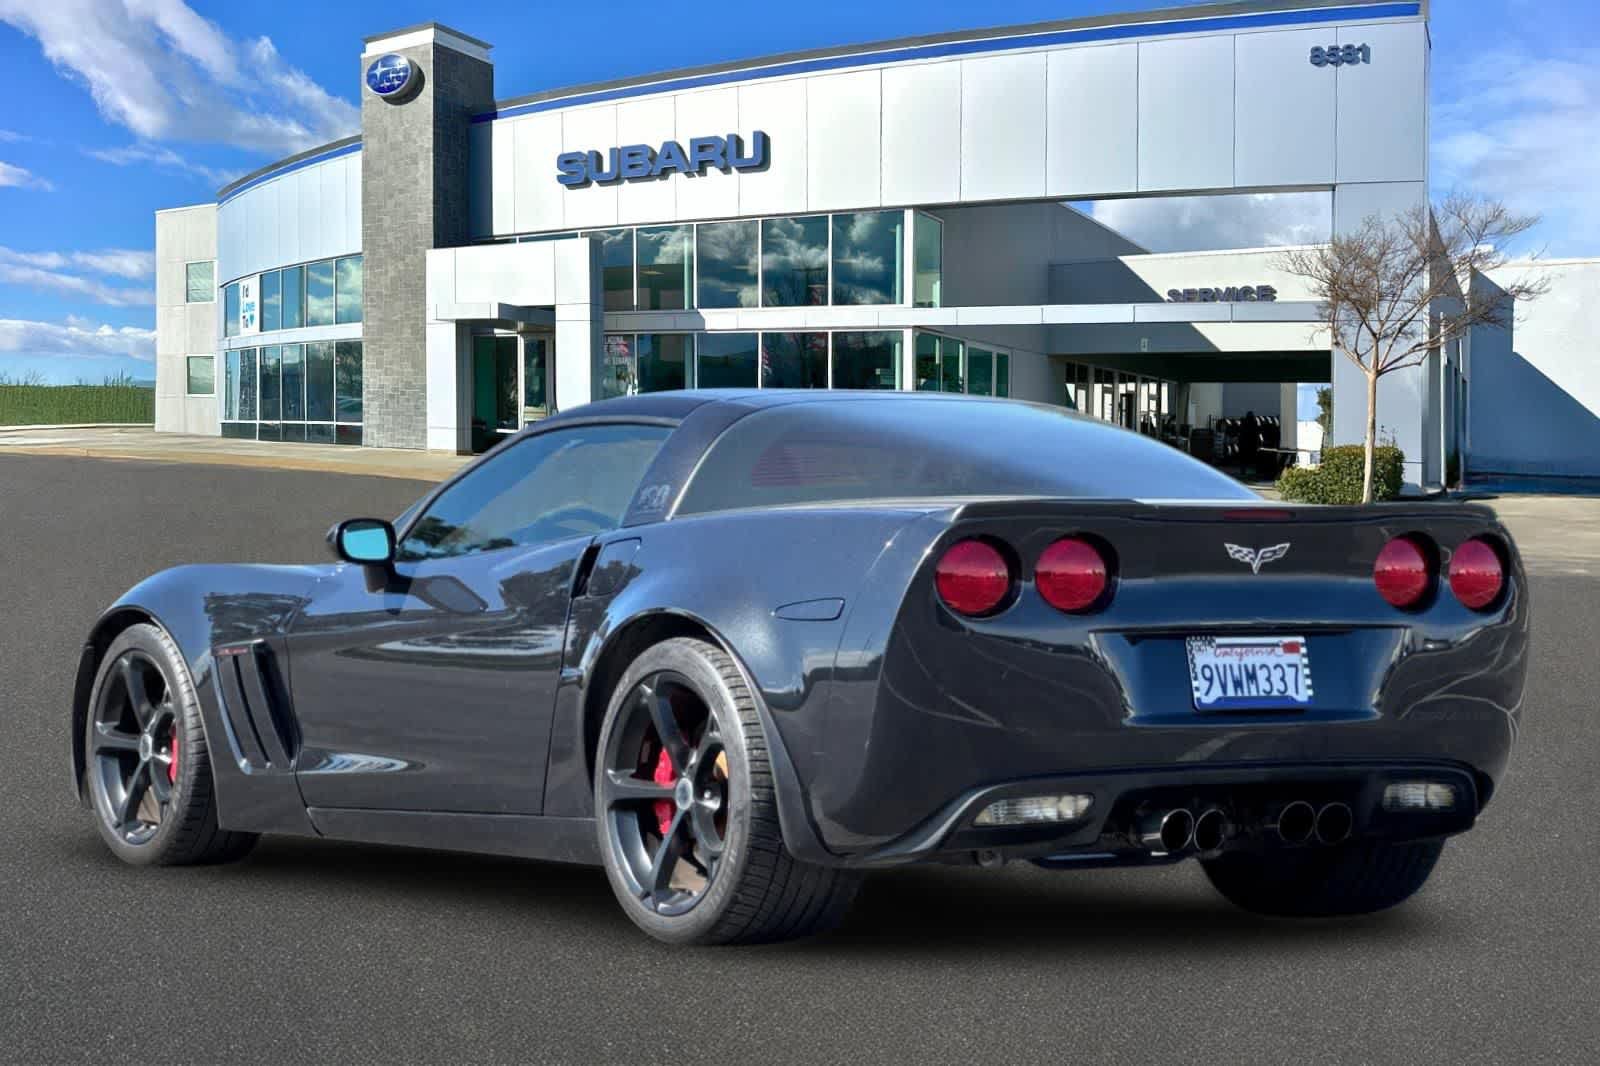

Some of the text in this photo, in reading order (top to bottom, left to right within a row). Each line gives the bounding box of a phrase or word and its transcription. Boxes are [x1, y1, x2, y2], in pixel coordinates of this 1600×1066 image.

[557, 130, 771, 190] SUBARU
[1167, 285, 1277, 302] SERVICE
[1201, 664, 1300, 696] 9VWM337
